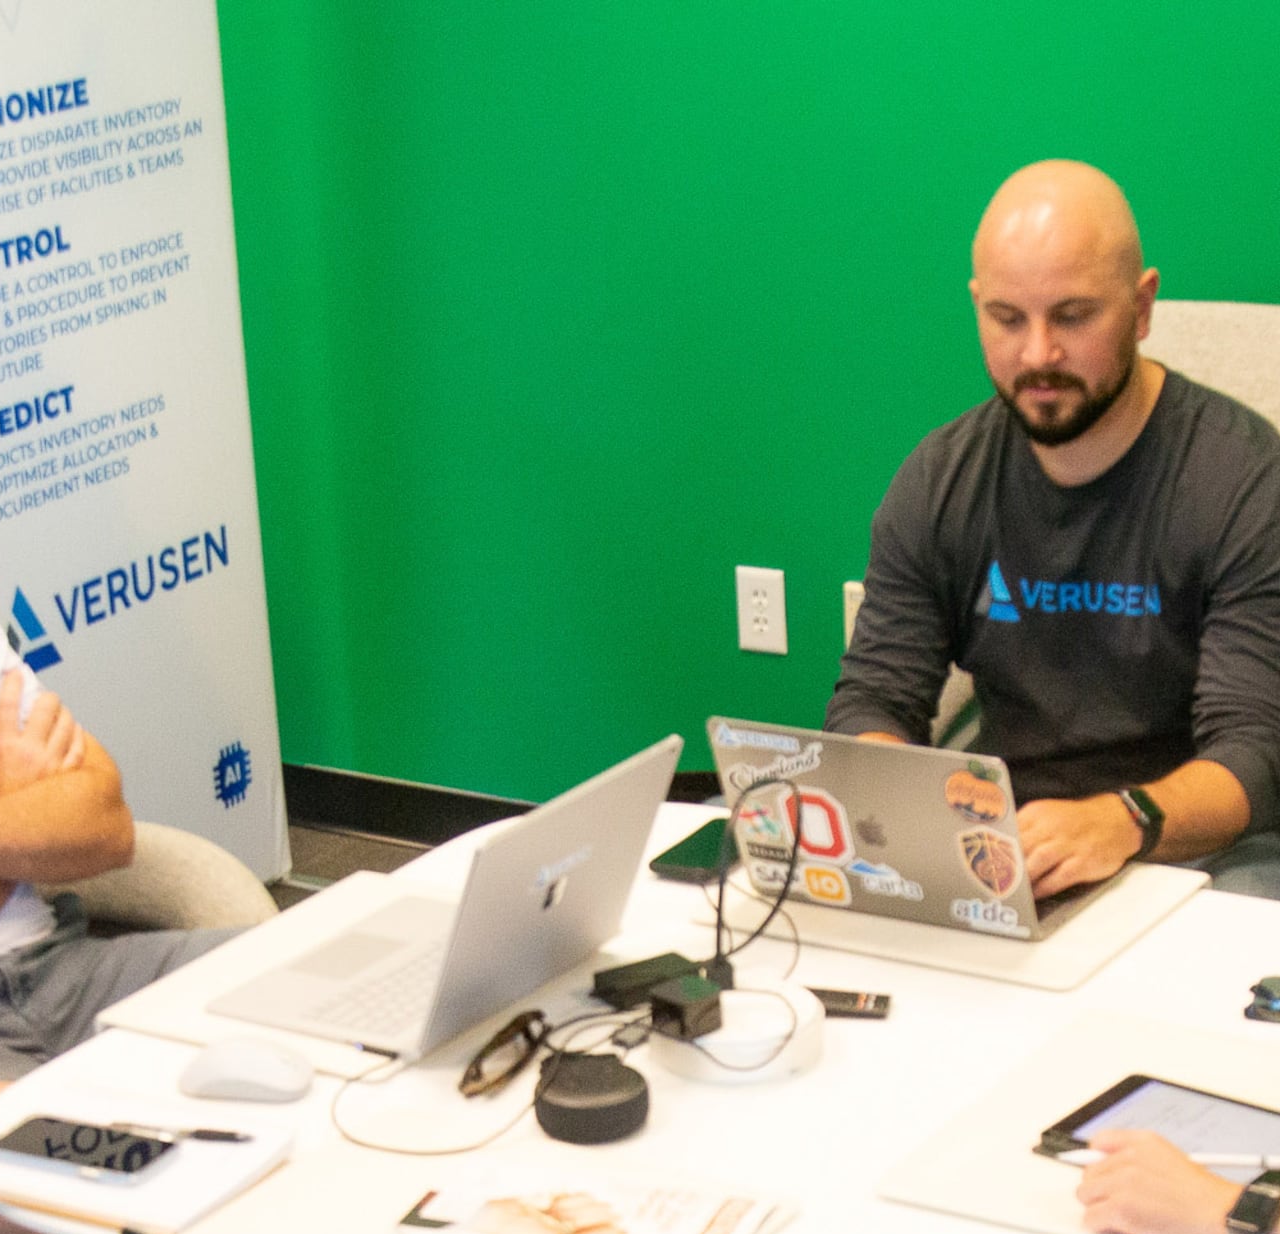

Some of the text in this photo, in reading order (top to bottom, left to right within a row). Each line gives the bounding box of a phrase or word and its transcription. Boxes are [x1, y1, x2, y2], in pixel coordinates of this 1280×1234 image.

[21, 118, 100, 152] DISPARATE
[104, 98, 182, 132] INVENTORY
[55, 138, 124, 171] VISIBILITY
[127, 126, 181, 153] ACROSS
[184, 117, 204, 138] AN
[27, 183, 48, 206] OF
[51, 164, 124, 200] FACILITIES
[127, 162, 137, 179] &
[139, 148, 185, 176] TEAMS
[4, 310, 14, 327] &
[17, 283, 106, 322] PROCEDURE
[109, 275, 128, 296] TO
[131, 254, 191, 288] PREVENT
[13, 281, 25, 297] A
[27, 261, 96, 294] CONTROL
[99, 252, 118, 271] TO
[121, 232, 184, 267] ENFORCE
[51, 312, 93, 339] FROM
[95, 295, 150, 325] SPIKING
[153, 287, 168, 306] IN
[39, 413, 116, 454] INVENTORY
[120, 395, 166, 423] NEEDS
[63, 425, 147, 472] ALLOCATION
[150, 422, 159, 439] &
[84, 456, 131, 487] NEEDS
[53, 523, 230, 634] VERUSEN
[1019, 577, 1162, 617] VERUSEN
[223, 760, 242, 788] AI
[955, 901, 1016, 926] atdc
